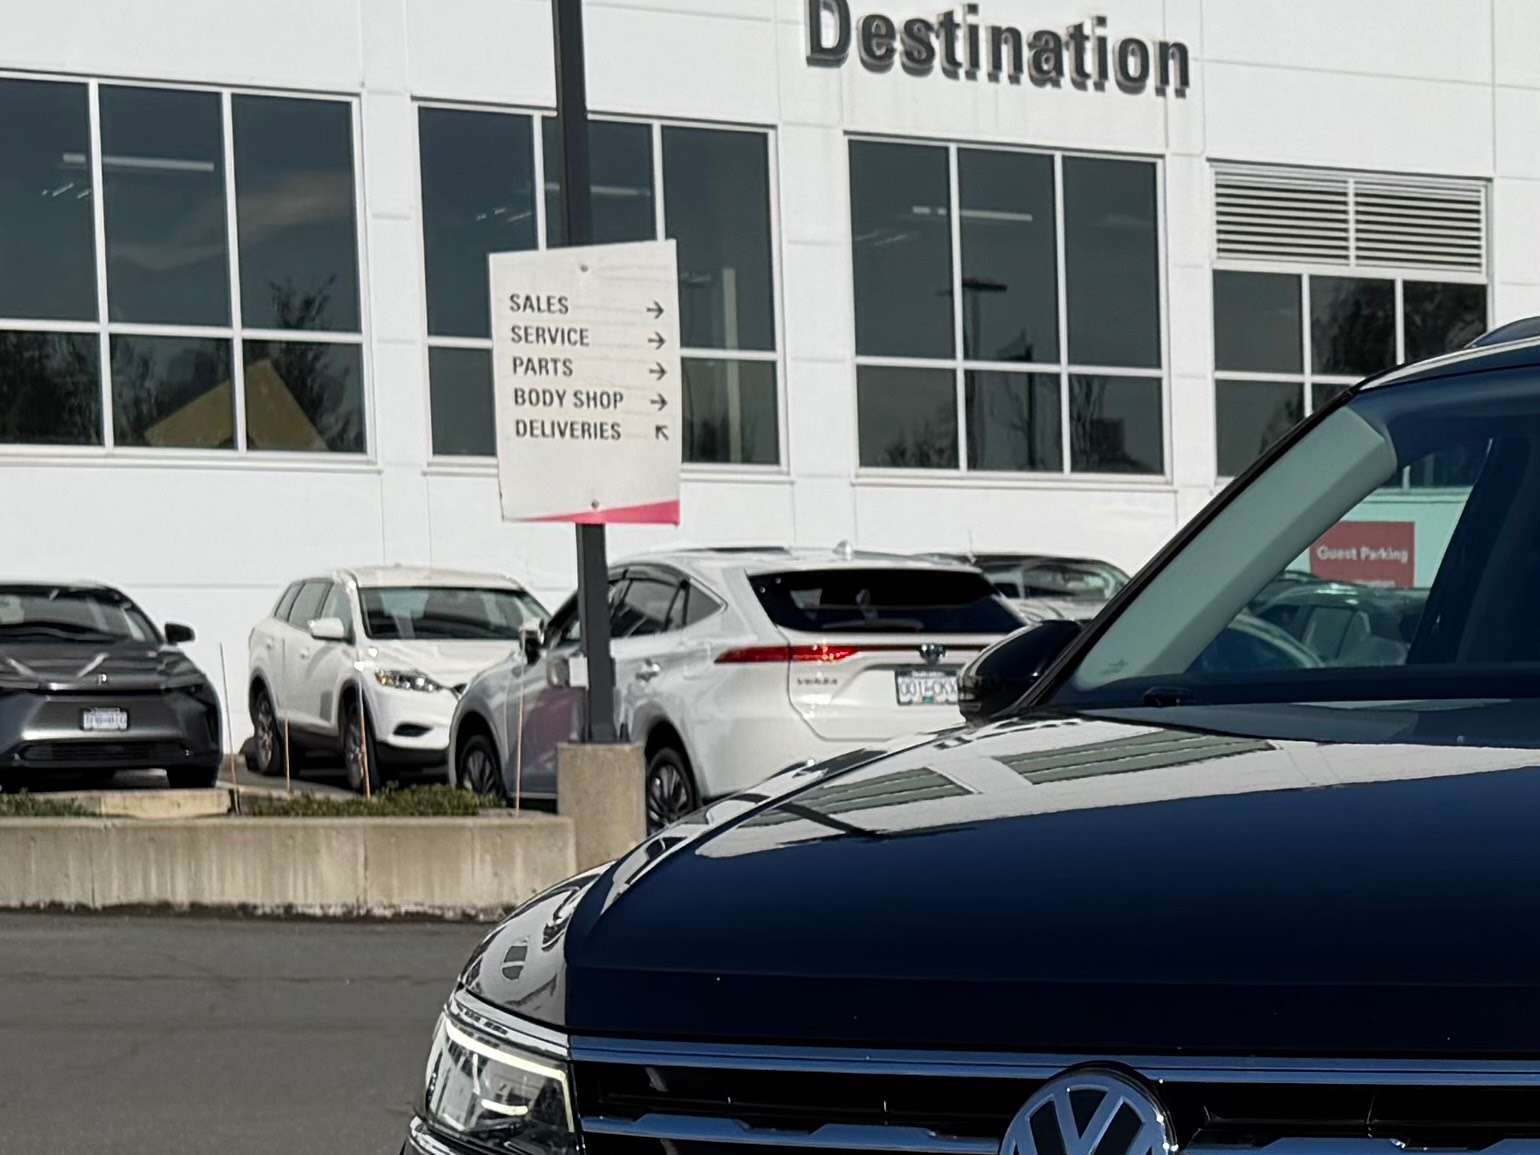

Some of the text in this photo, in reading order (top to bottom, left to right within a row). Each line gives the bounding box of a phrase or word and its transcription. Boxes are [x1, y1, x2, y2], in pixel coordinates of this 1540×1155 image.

[806, 0, 1190, 98] Destination
[509, 293, 569, 315] SALES
[511, 325, 590, 347] SERVICE
[512, 356, 573, 377] PARTS
[514, 387, 624, 409] BODY SHOP
[515, 419, 622, 441] DELIVERIES
[1317, 545, 1408, 564] Guest Parking
